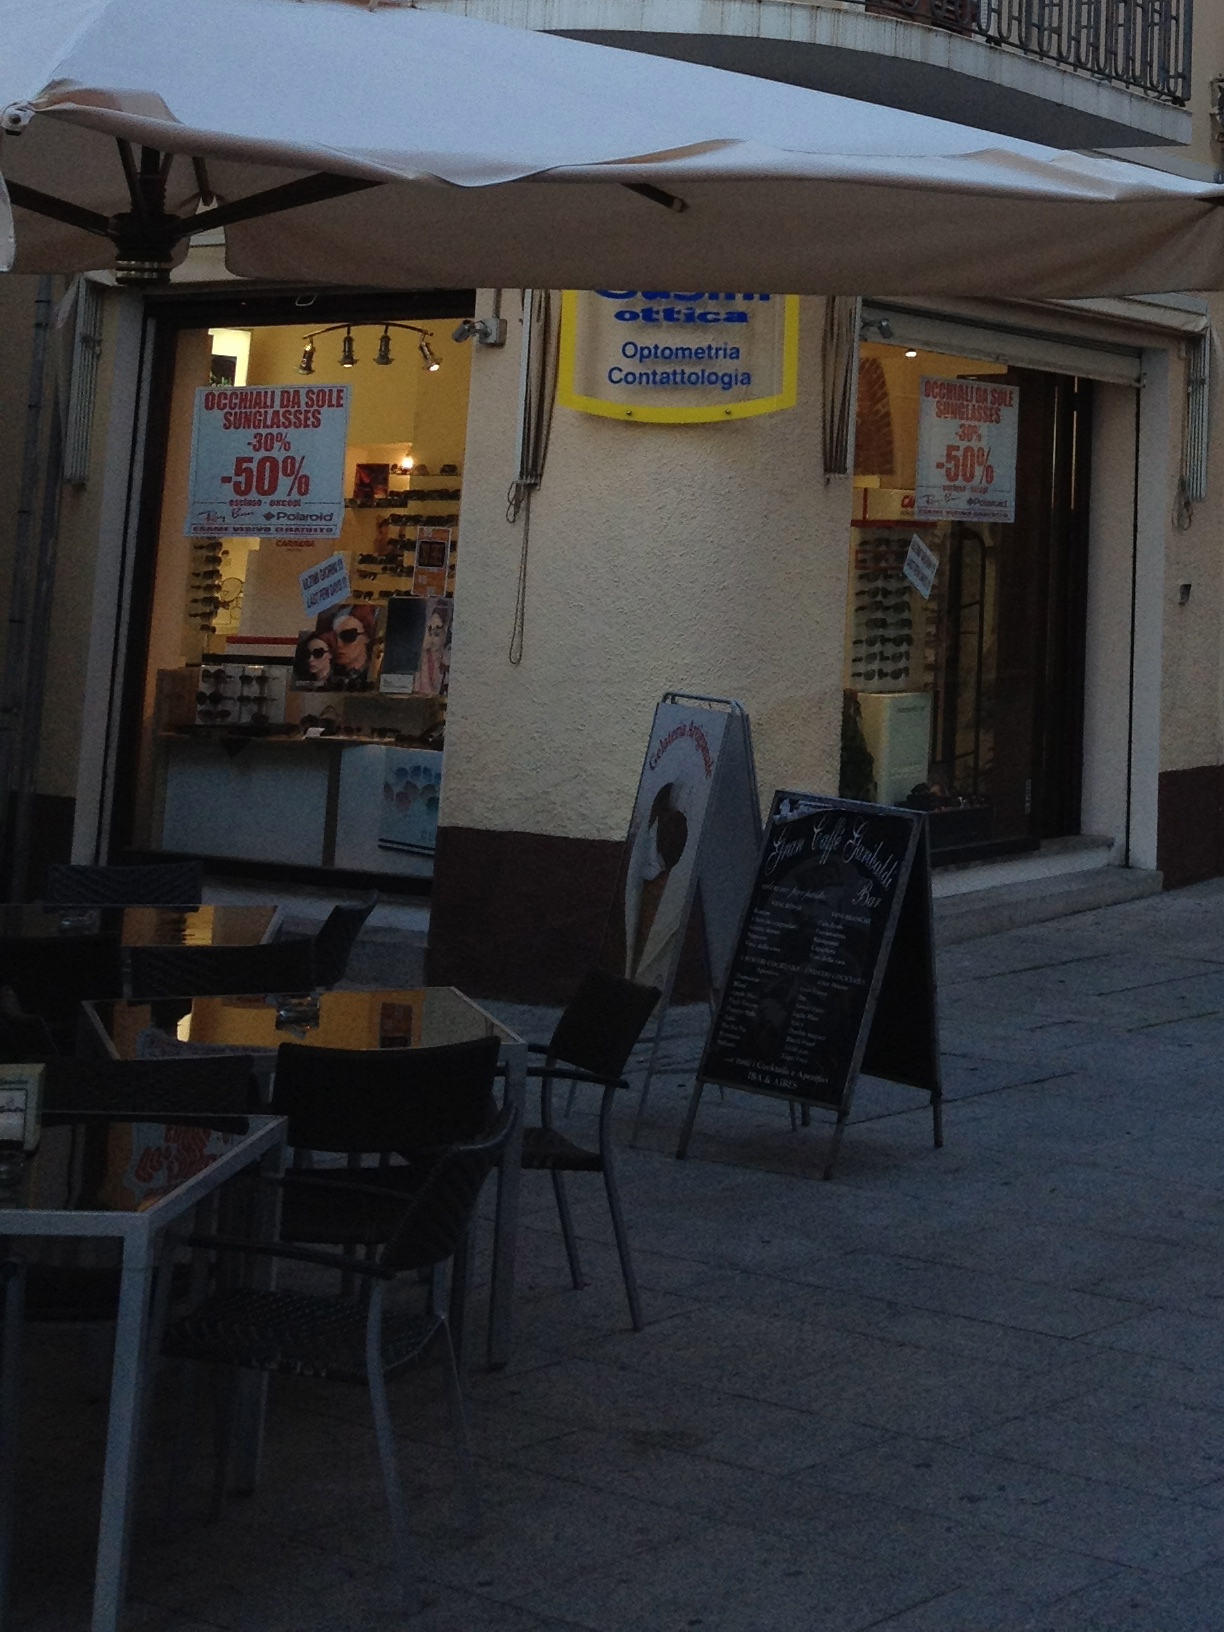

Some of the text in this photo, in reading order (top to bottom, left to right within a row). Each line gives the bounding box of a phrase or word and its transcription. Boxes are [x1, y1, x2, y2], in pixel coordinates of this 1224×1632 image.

[614, 307, 748, 324] ottica
[622, 342, 740, 363] Optometria
[608, 367, 752, 390] Contattologia
[205, 388, 344, 411] OCCHIALI DA SOLE
[924, 380, 1014, 408] OCCHIALI DA SOLE
[223, 409, 321, 430] SUNGLASSES
[935, 400, 1001, 425] SUNGLASSES
[247, 432, 291, 452] -30%
[955, 423, 982, 442] -30%
[221, 455, 310, 497] -50%
[936, 445, 994, 485] -50%
[276, 511, 334, 522] Polaroid
[649, 723, 687, 771] Gelateria
[765, 825, 806, 877] Gran
[842, 816, 899, 890] Garibaldi
[851, 879, 883, 909] Bar
